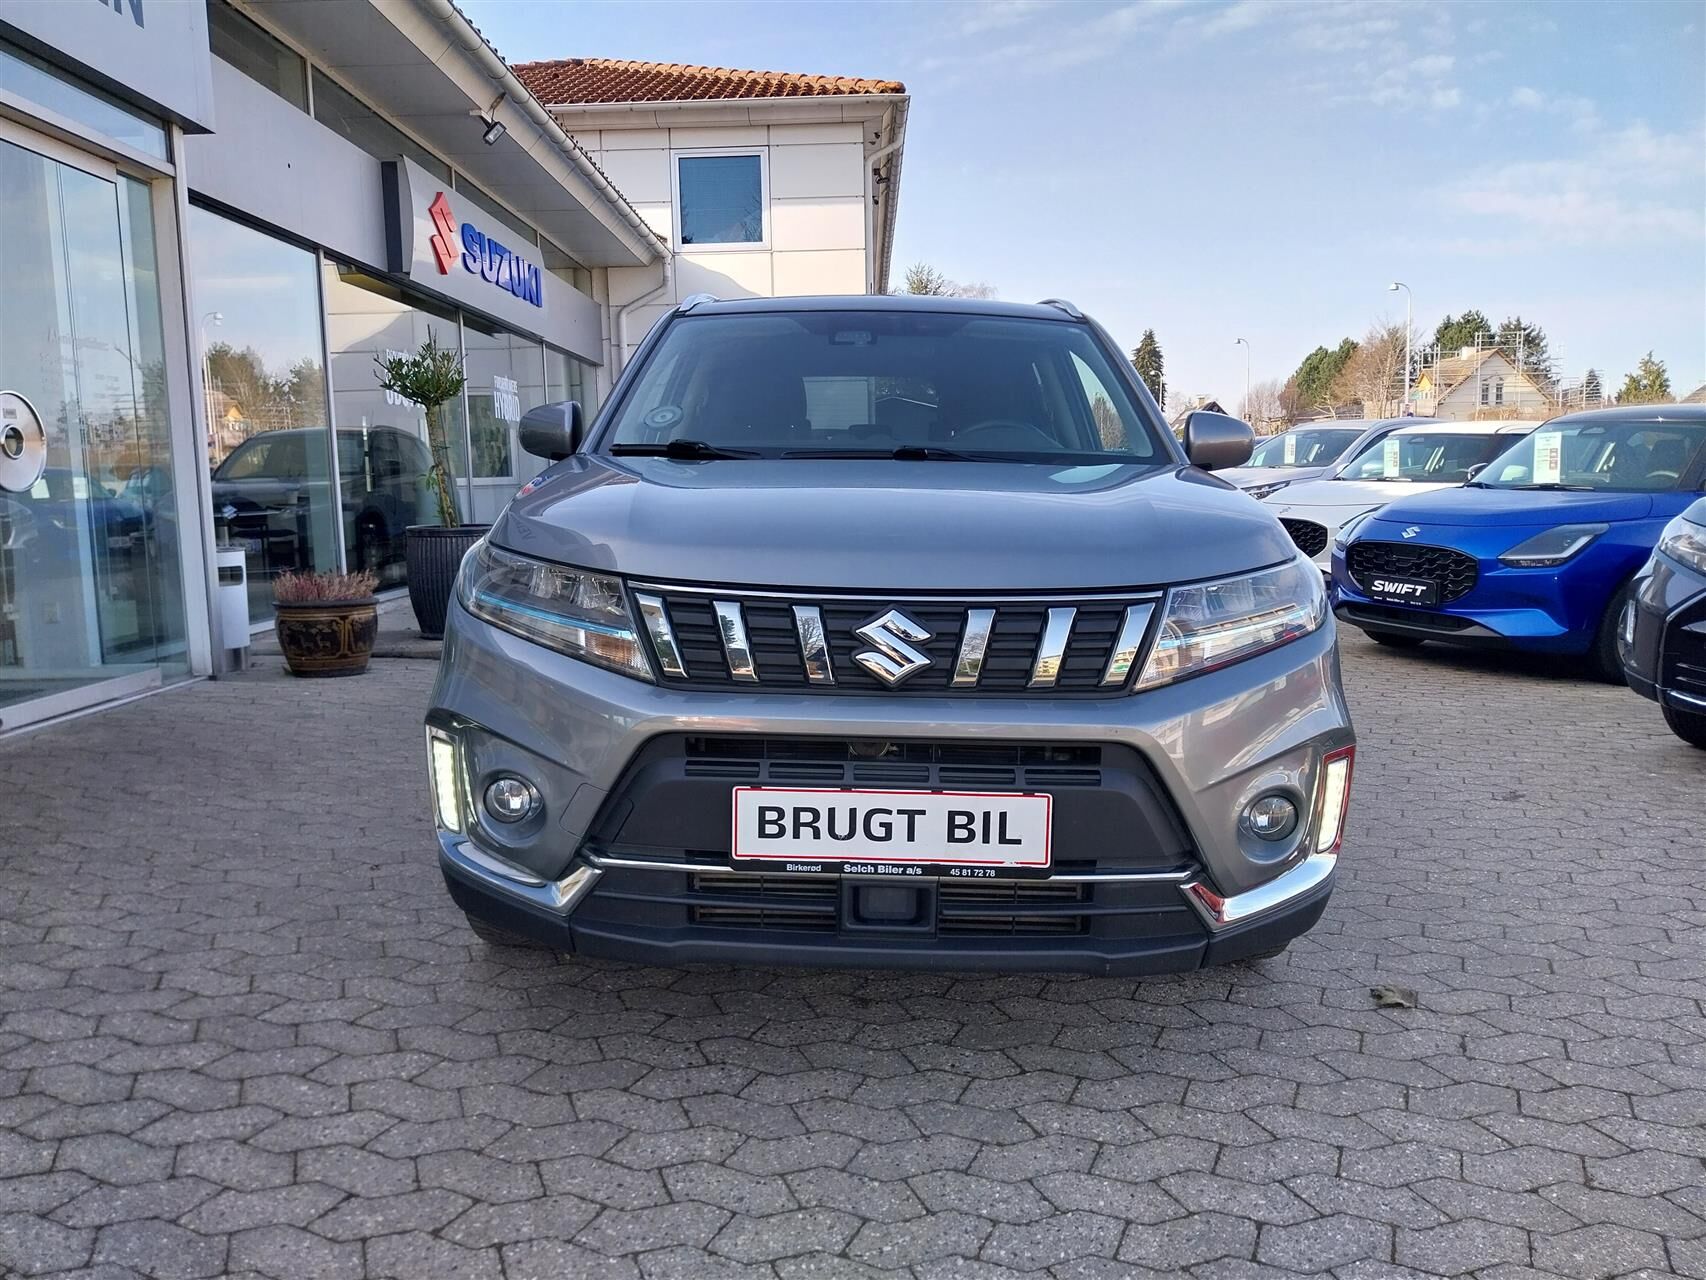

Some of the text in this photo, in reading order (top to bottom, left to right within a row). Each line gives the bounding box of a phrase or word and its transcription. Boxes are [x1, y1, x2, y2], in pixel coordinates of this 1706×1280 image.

[461, 223, 543, 308] SUZUKI
[1371, 580, 1427, 596] SWIFT
[757, 805, 1022, 846] BRUGT BIL
[786, 863, 996, 878] Birkerød Selch Biler a/s 45 81 72 78
